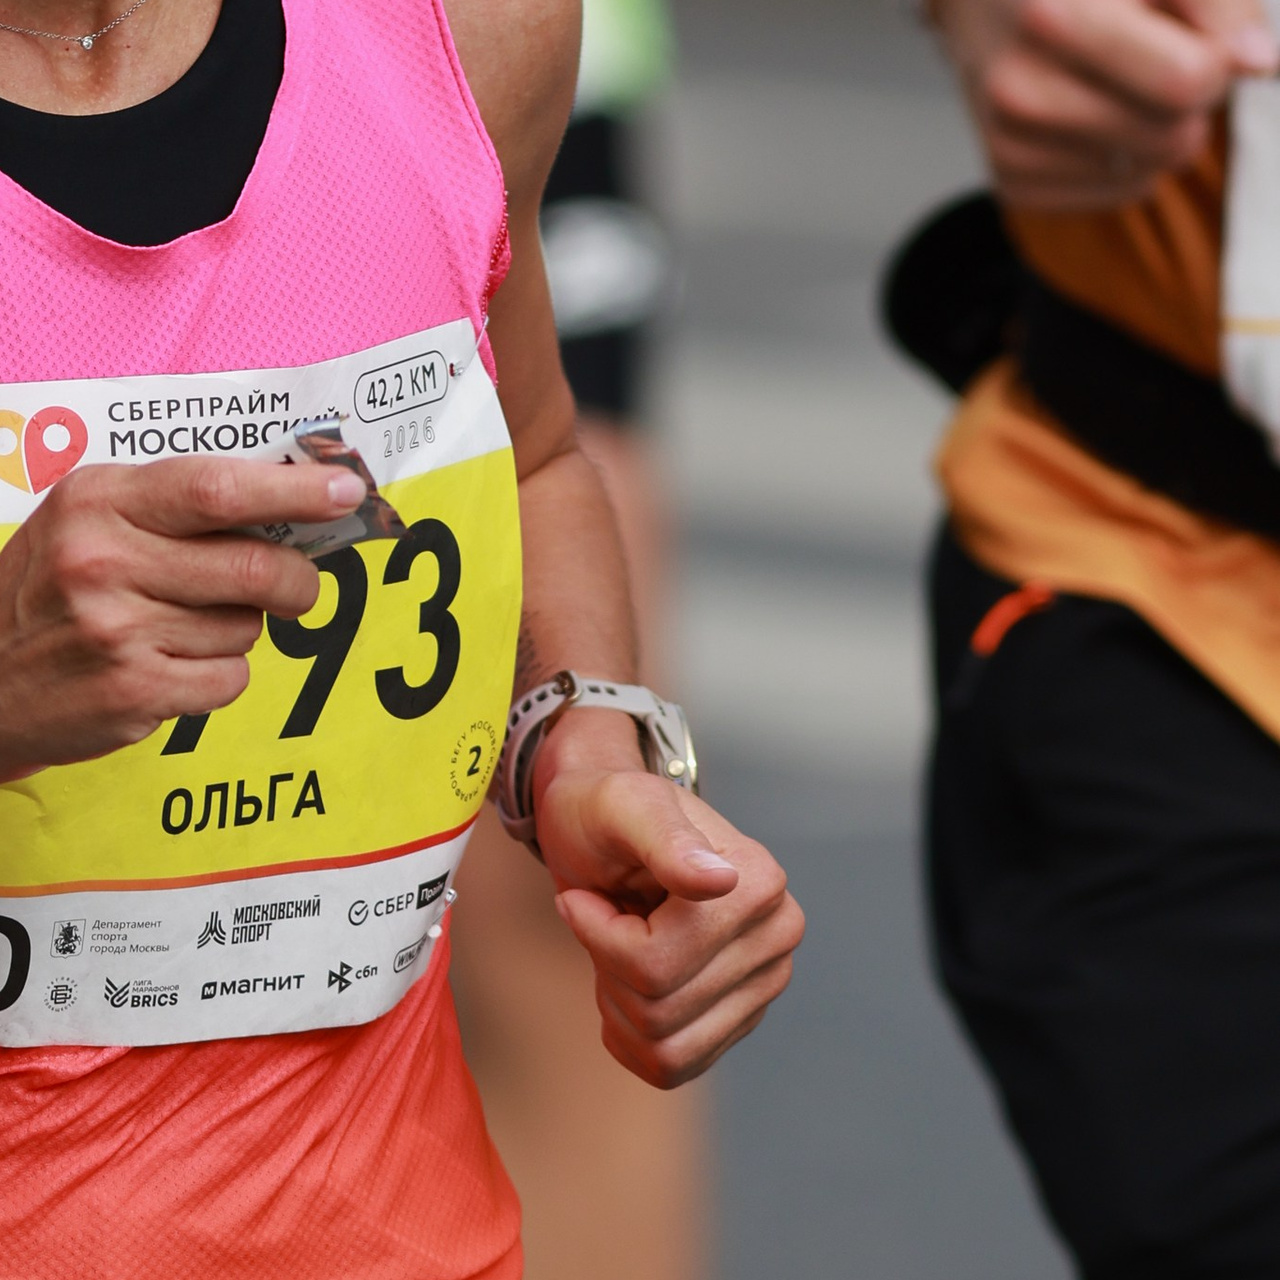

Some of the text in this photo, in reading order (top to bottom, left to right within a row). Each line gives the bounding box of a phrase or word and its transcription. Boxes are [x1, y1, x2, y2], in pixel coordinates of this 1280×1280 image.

[366, 373, 404, 408] 42,2
[108, 389, 291, 423] СБЕРПРАЙМ
[383, 415, 436, 458] 2026
[160, 518, 462, 756] 93
[466, 745, 482, 777] 2
[160, 769, 327, 835] ОЛЬГА
[233, 894, 321, 926] МОСКОВСКИЙ
[373, 892, 415, 917] СБЕР
[91, 919, 163, 931] Департамент
[231, 922, 273, 945] СПОРТ
[89, 943, 170, 955] города Москвы
[91, 933, 128, 942] спорта
[355, 965, 378, 980] сбп
[131, 985, 180, 994] МАРАФОНОВ
[219, 974, 306, 996] магнит
[130, 992, 179, 1008] BRICS
